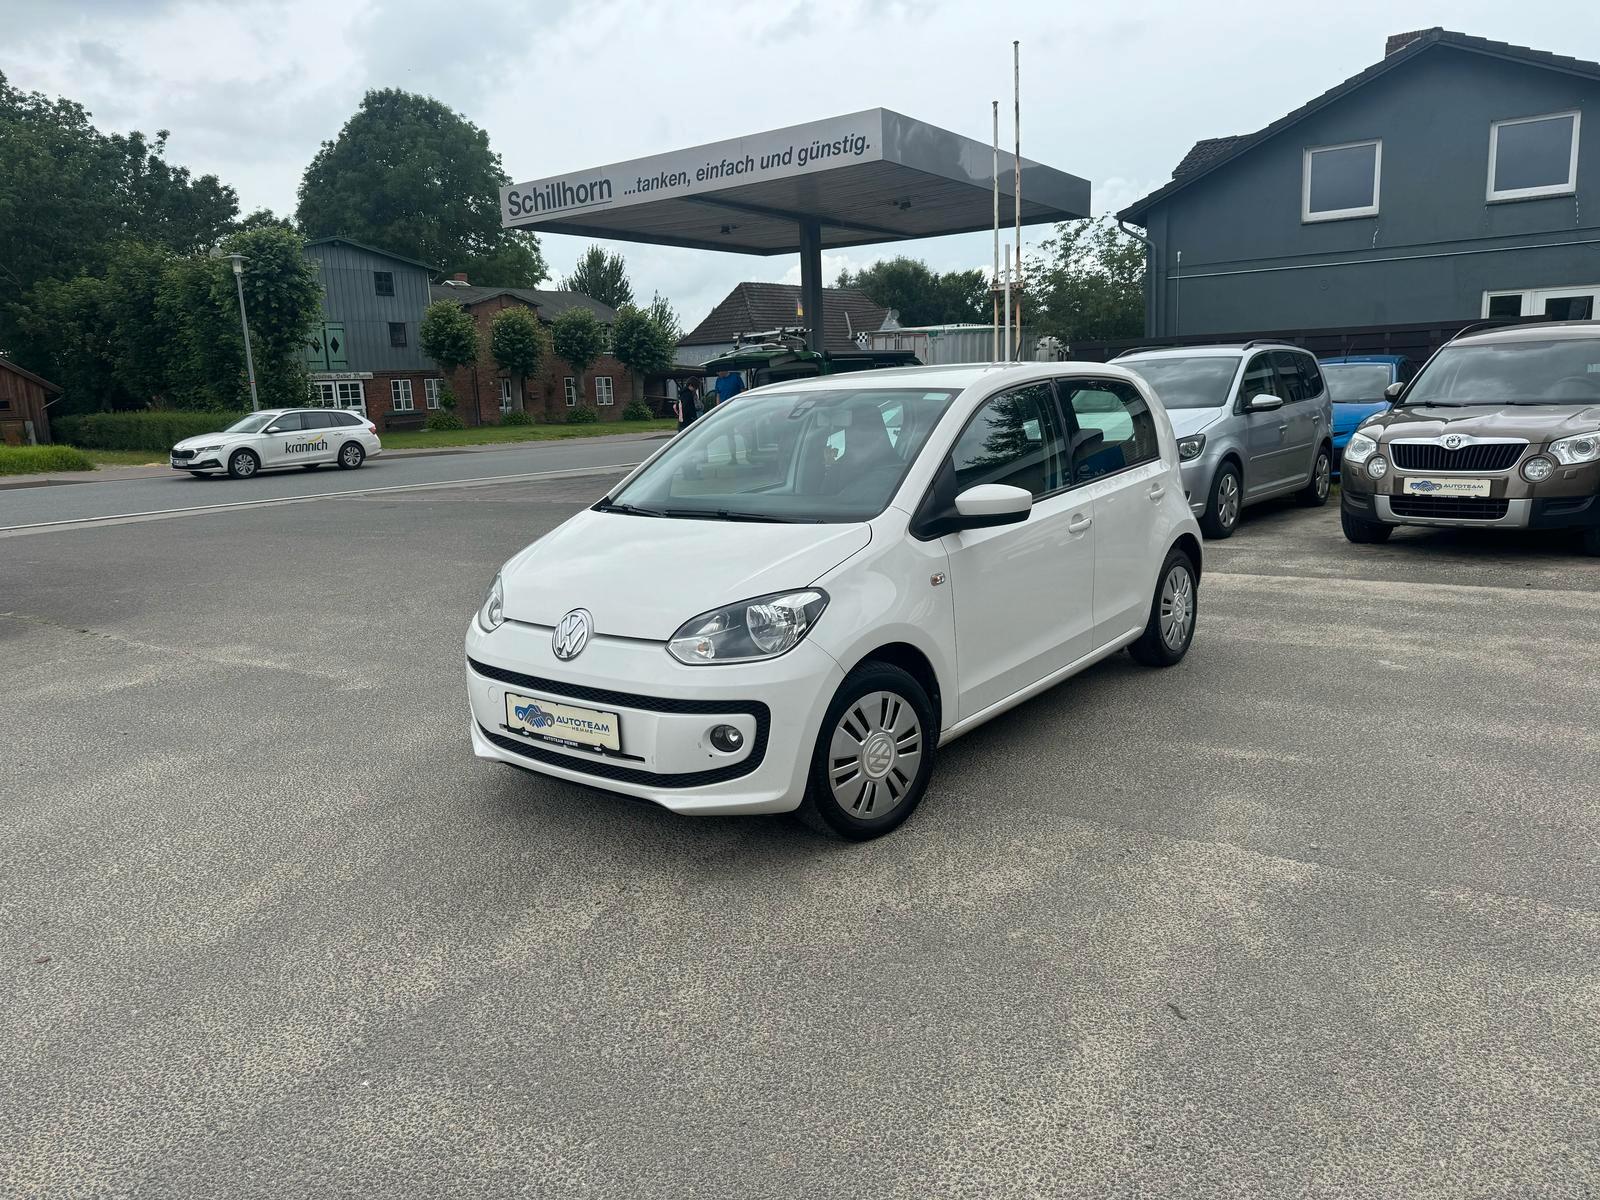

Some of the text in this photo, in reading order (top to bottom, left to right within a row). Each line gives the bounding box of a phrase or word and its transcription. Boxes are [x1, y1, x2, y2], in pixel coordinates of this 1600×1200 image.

[624, 132, 871, 196] ...tanken, einfach und günstig.
[508, 175, 612, 216] Schillhorn
[285, 439, 328, 454] krannich
[556, 715, 610, 733] AUTOTEAM
[571, 726, 594, 735] HEMME
[543, 735, 564, 744] AUTOTEAM
